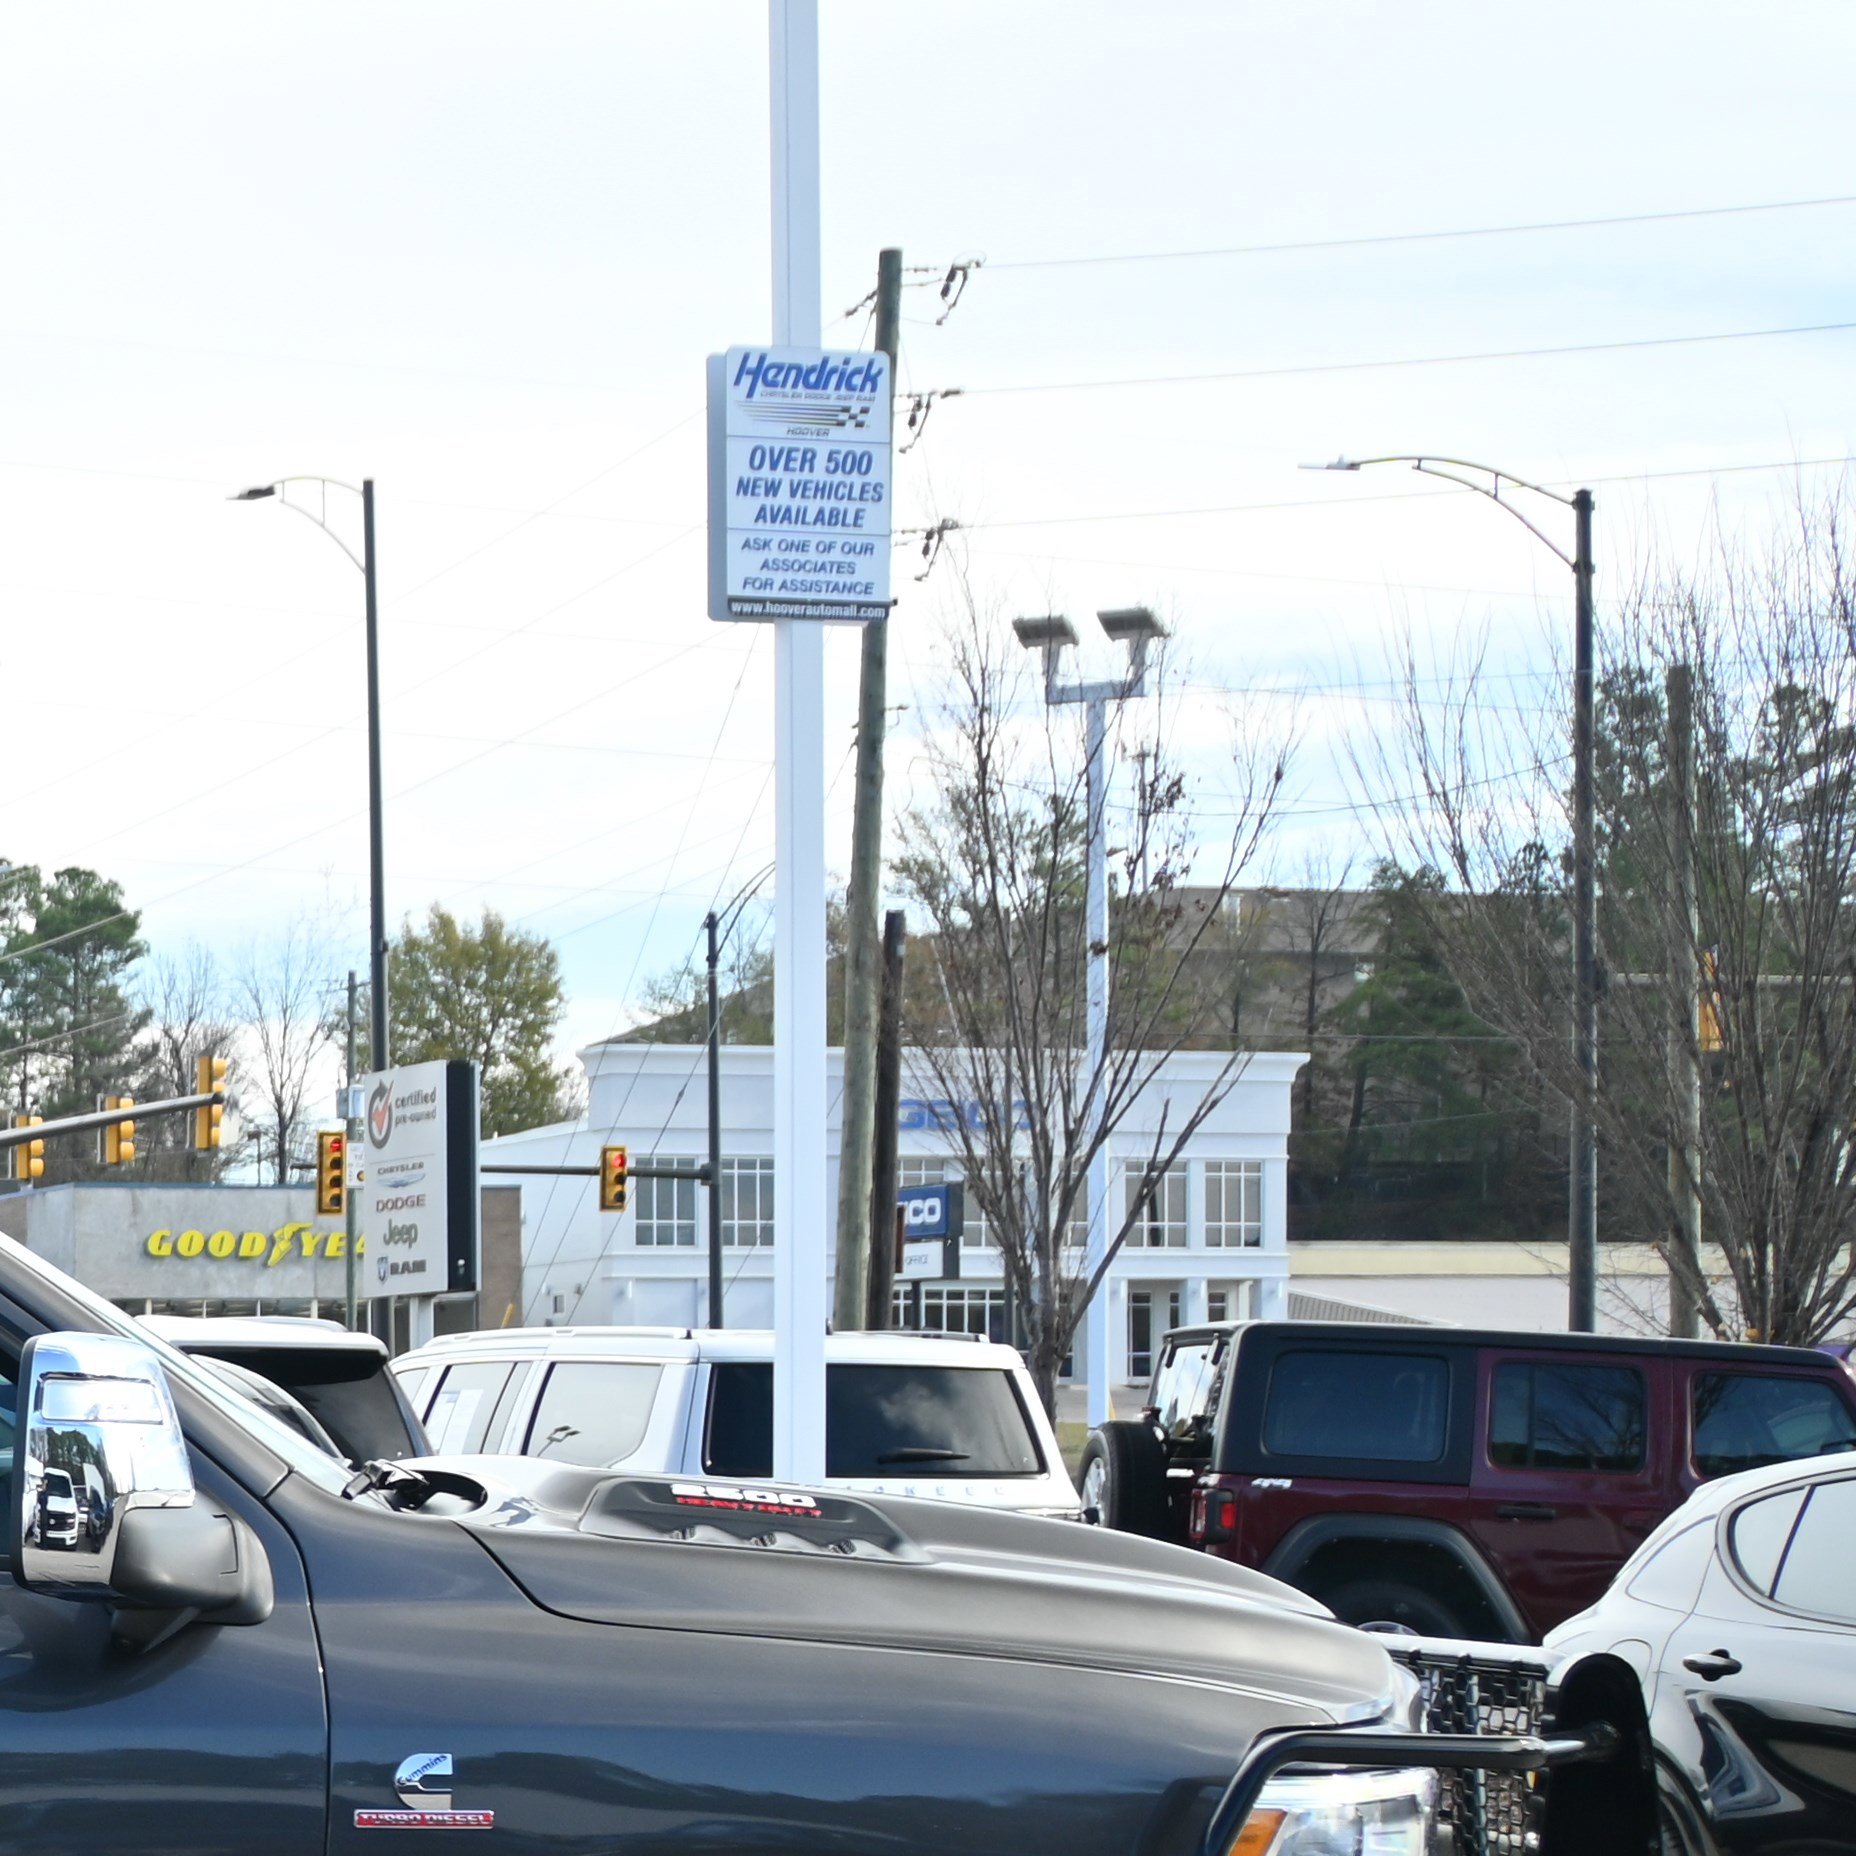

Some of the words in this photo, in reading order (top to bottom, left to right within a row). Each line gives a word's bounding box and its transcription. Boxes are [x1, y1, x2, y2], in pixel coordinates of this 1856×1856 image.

[733, 351, 883, 399] Hendrick
[786, 427, 830, 437] HOOVER
[749, 444, 817, 473] OVER
[825, 449, 873, 476] 500
[736, 476, 782, 498] NEW
[789, 479, 884, 502] VEHICLES
[754, 503, 866, 528] AVAILABLE
[741, 537, 773, 551] ASK
[777, 538, 811, 553] ONE
[815, 540, 837, 554] OF
[840, 541, 875, 556] OUR
[760, 558, 856, 575] ASSOCIATES
[742, 577, 774, 592] FOR
[778, 579, 875, 595] ASSISTANCE
[731, 601, 885, 618] www.hooverautomall.com
[395, 1086, 437, 1108] certified
[377, 1161, 425, 1175] CHRYSLER
[376, 1194, 426, 1213] DODGE
[147, 1227, 365, 1260] GOODYE
[383, 1218, 418, 1249] Jeep
[390, 1259, 427, 1275] RAM
[397, 1755, 448, 1786] Cummins
